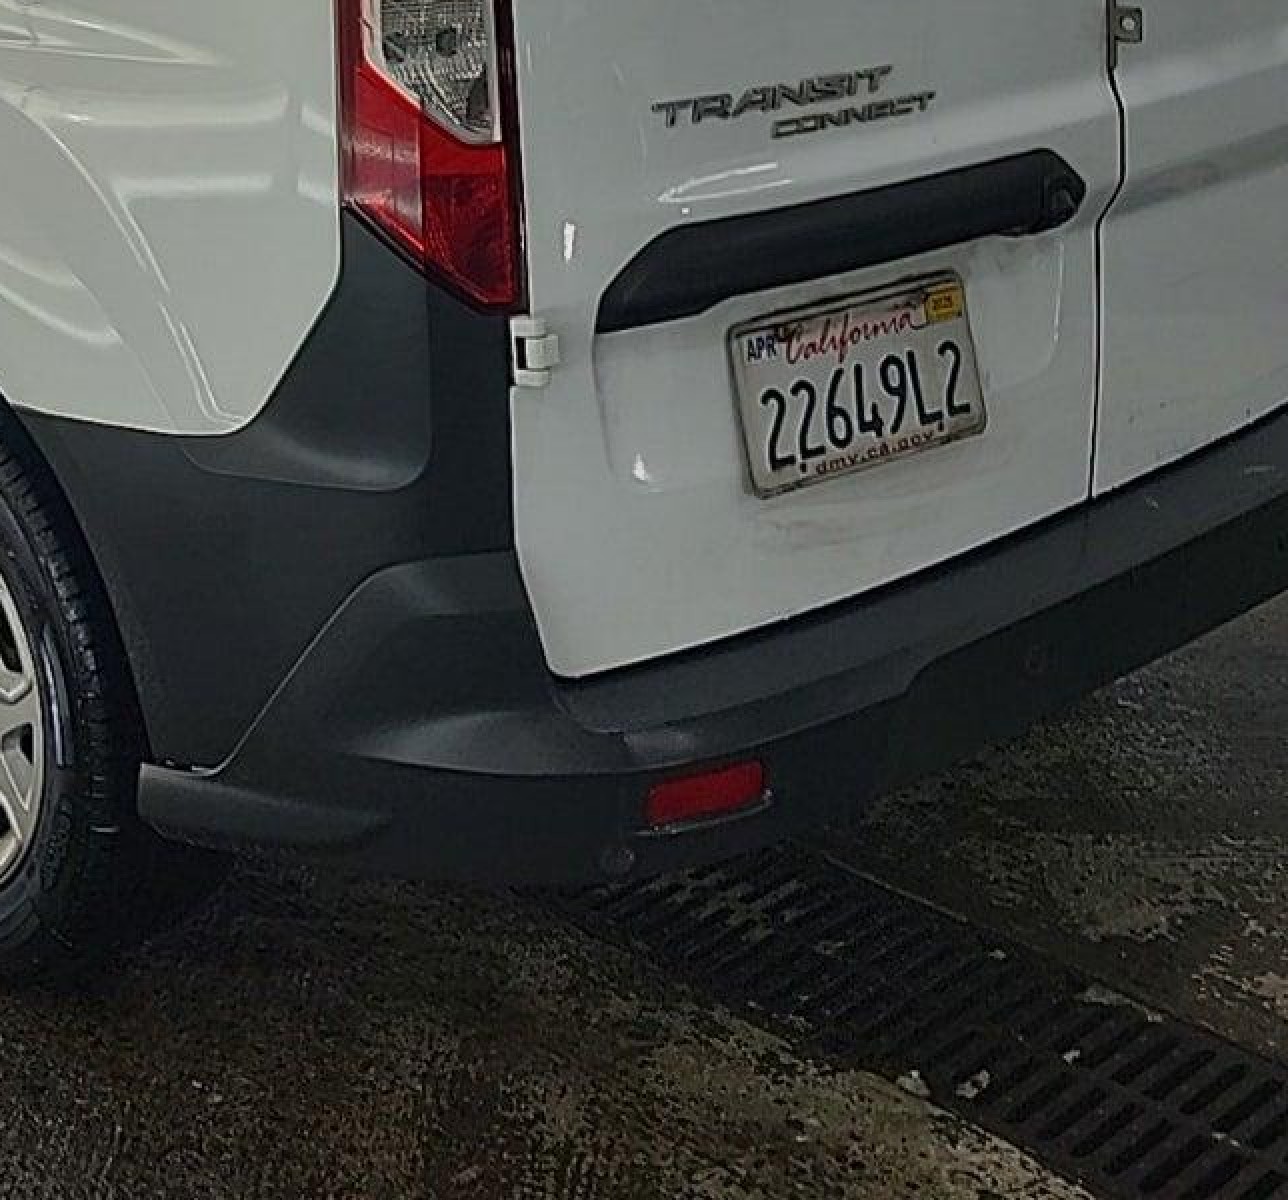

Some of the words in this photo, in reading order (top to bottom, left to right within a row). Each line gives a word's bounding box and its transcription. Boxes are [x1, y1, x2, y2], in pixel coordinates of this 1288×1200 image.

[651, 64, 893, 128] TRANSIT
[771, 91, 936, 139] CONNECT
[746, 334, 778, 362] APR
[778, 310, 917, 364] California
[760, 340, 970, 471] 22649L2
